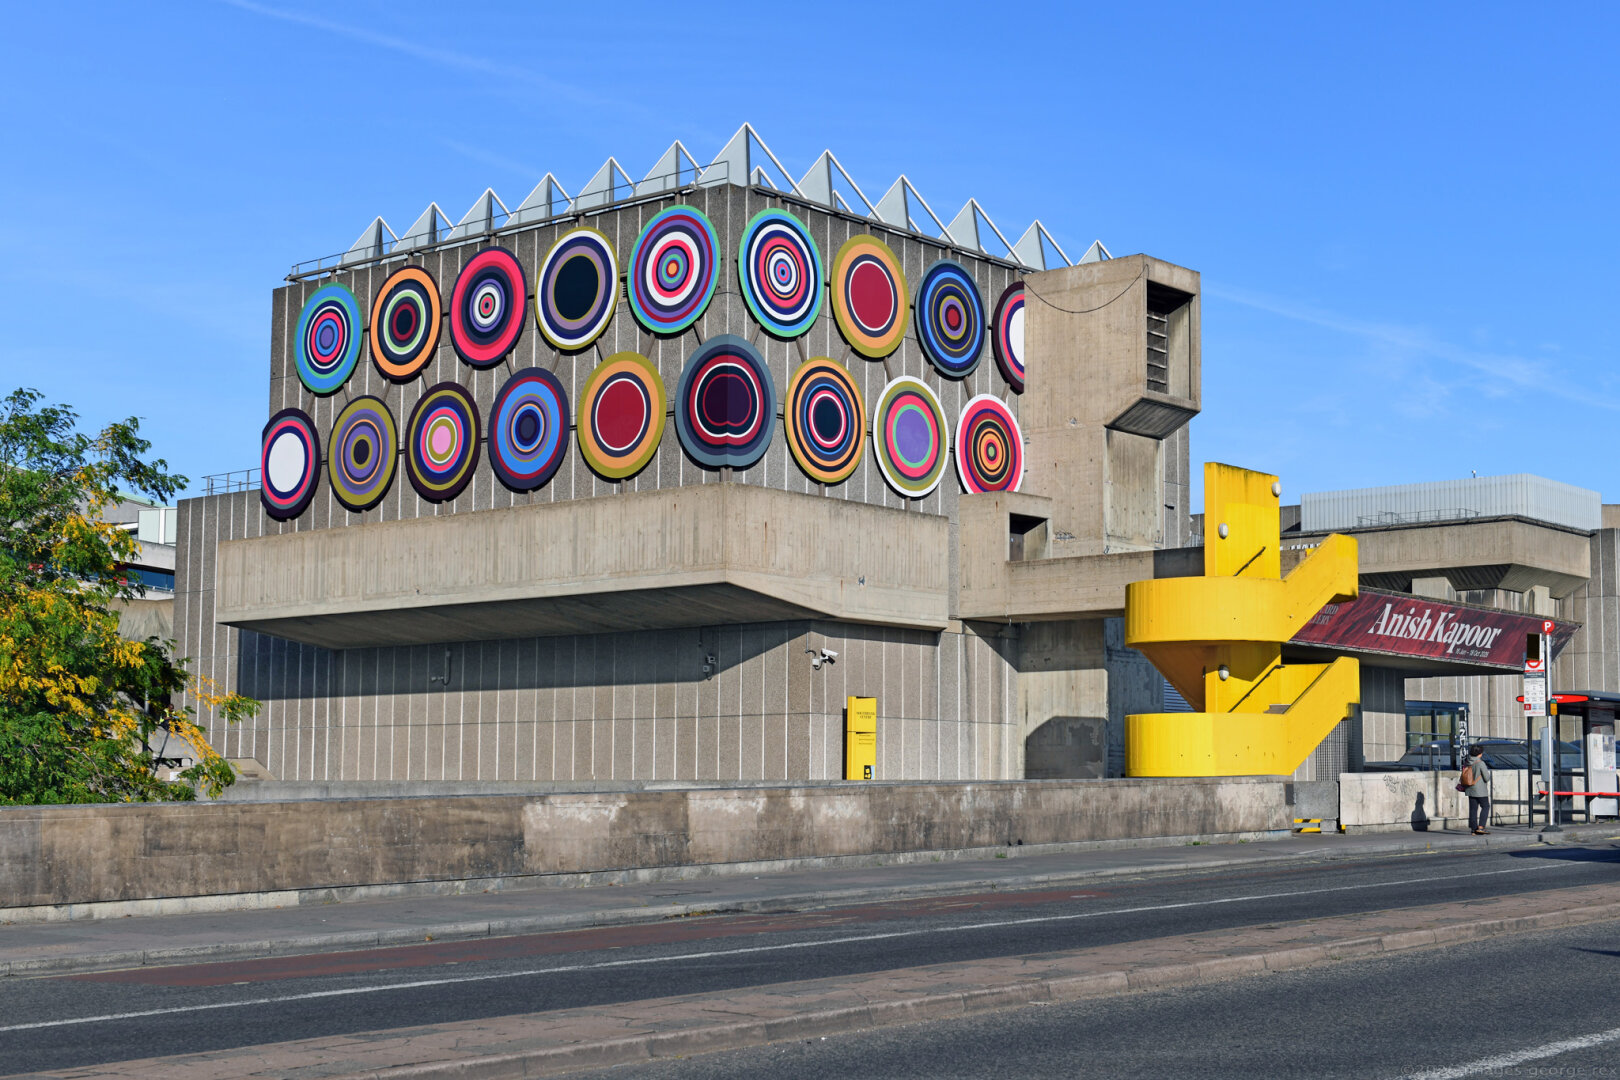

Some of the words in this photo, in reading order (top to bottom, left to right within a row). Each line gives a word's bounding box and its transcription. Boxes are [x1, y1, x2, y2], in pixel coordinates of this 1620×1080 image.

[1367, 603, 1432, 640] Anish
[1427, 611, 1503, 653] Kapoor
[1544, 621, 1552, 632] P
